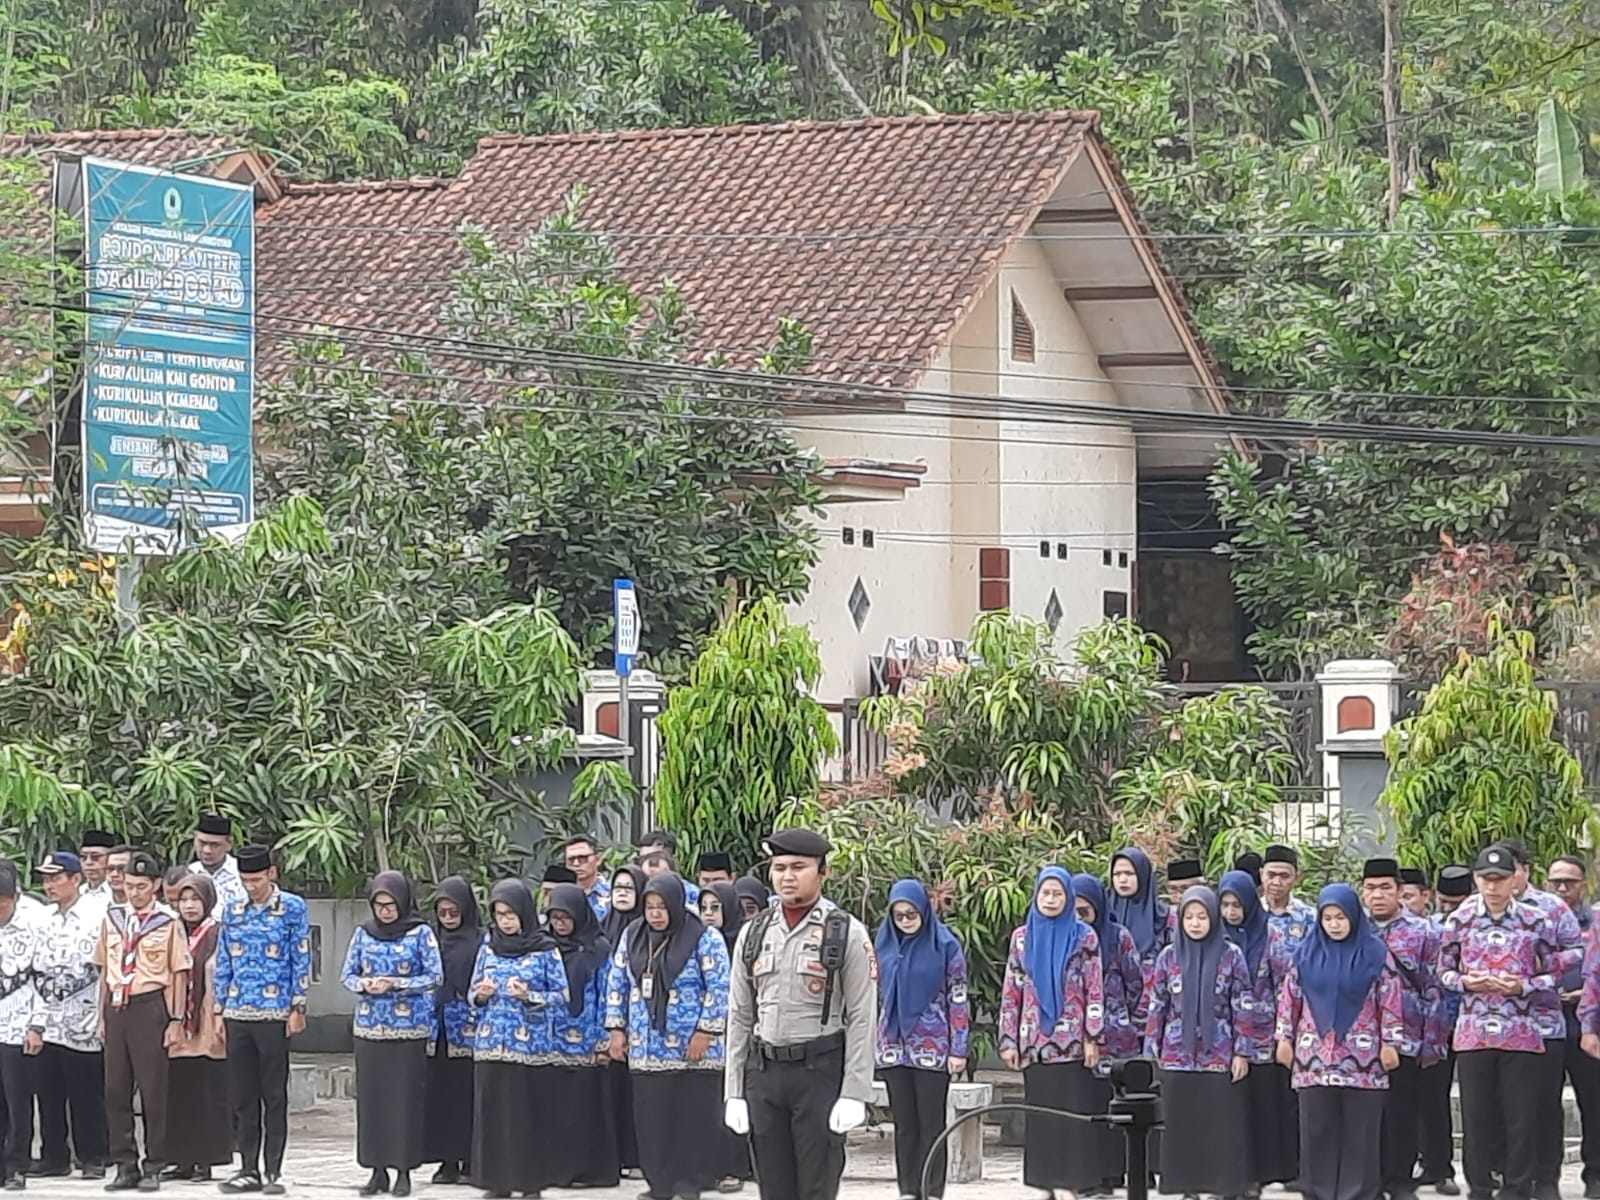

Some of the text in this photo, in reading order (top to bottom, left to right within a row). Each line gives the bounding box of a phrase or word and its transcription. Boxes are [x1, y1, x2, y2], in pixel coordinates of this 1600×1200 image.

[99, 363, 236, 392] KURIKULUM KMI GONTOR
[99, 386, 164, 405] KURIKULUM
